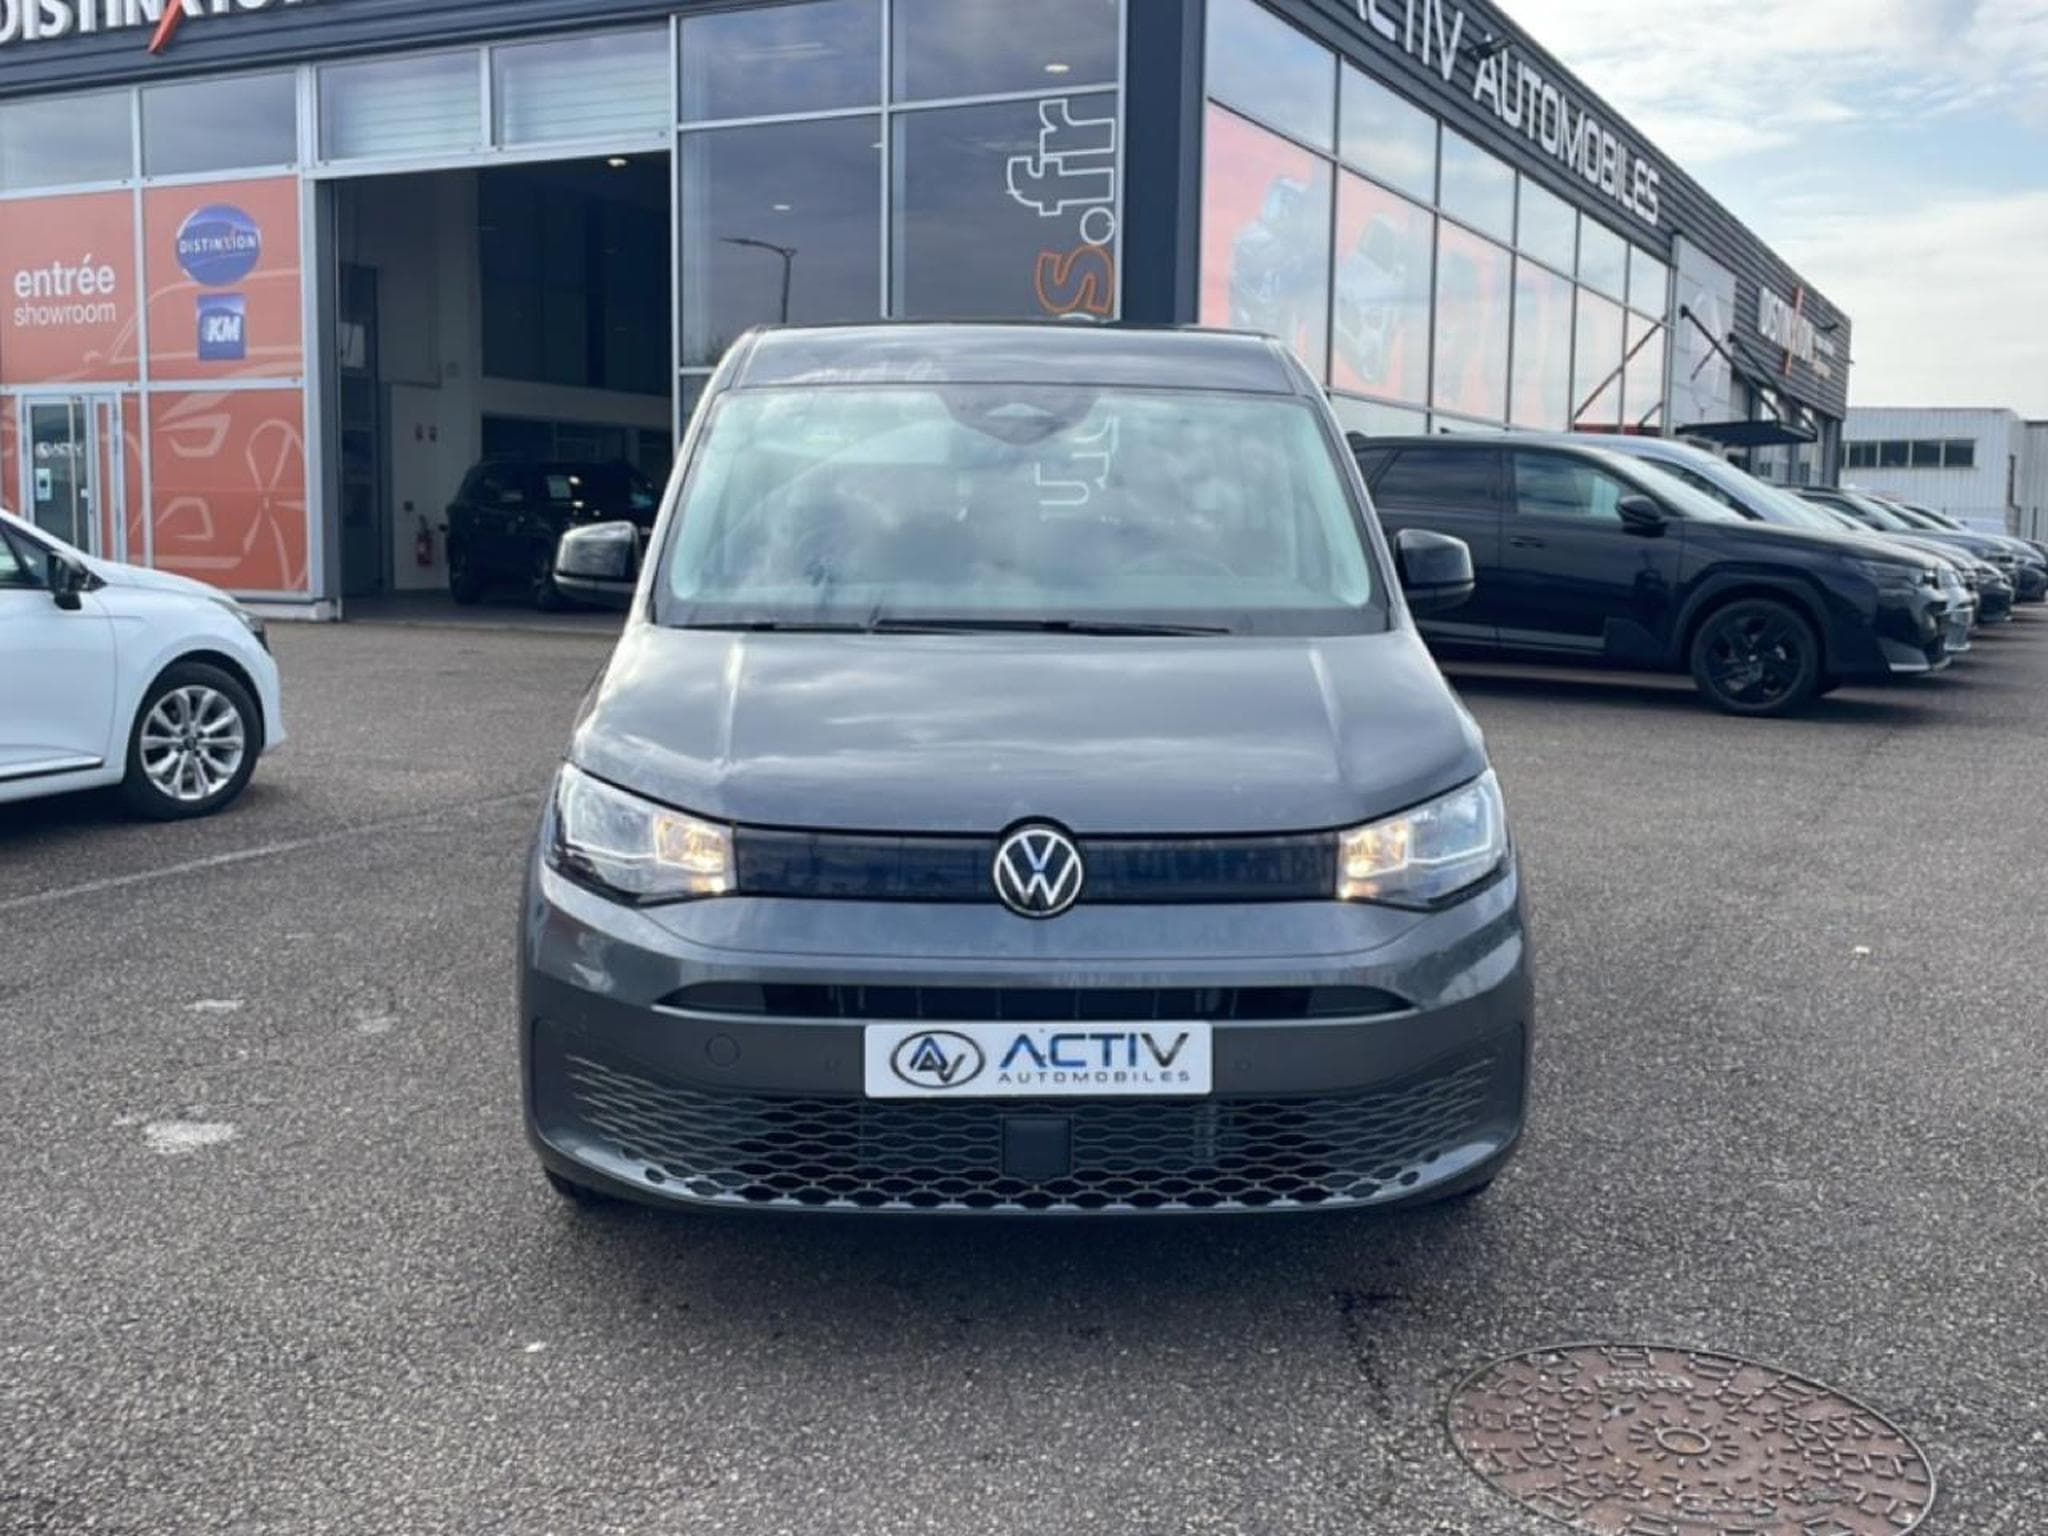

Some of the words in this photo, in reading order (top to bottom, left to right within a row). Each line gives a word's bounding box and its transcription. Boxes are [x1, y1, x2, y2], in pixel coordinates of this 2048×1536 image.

[1357, 0, 1463, 81] TIV
[1473, 32, 1659, 225] AUTOMOBILES
[1007, 98, 1116, 321] s.fr
[14, 253, 115, 298] entrée
[14, 302, 116, 327] showroom
[999, 1033, 1190, 1069] ACTIV
[998, 1070, 1190, 1084] AUTOMOBILES
